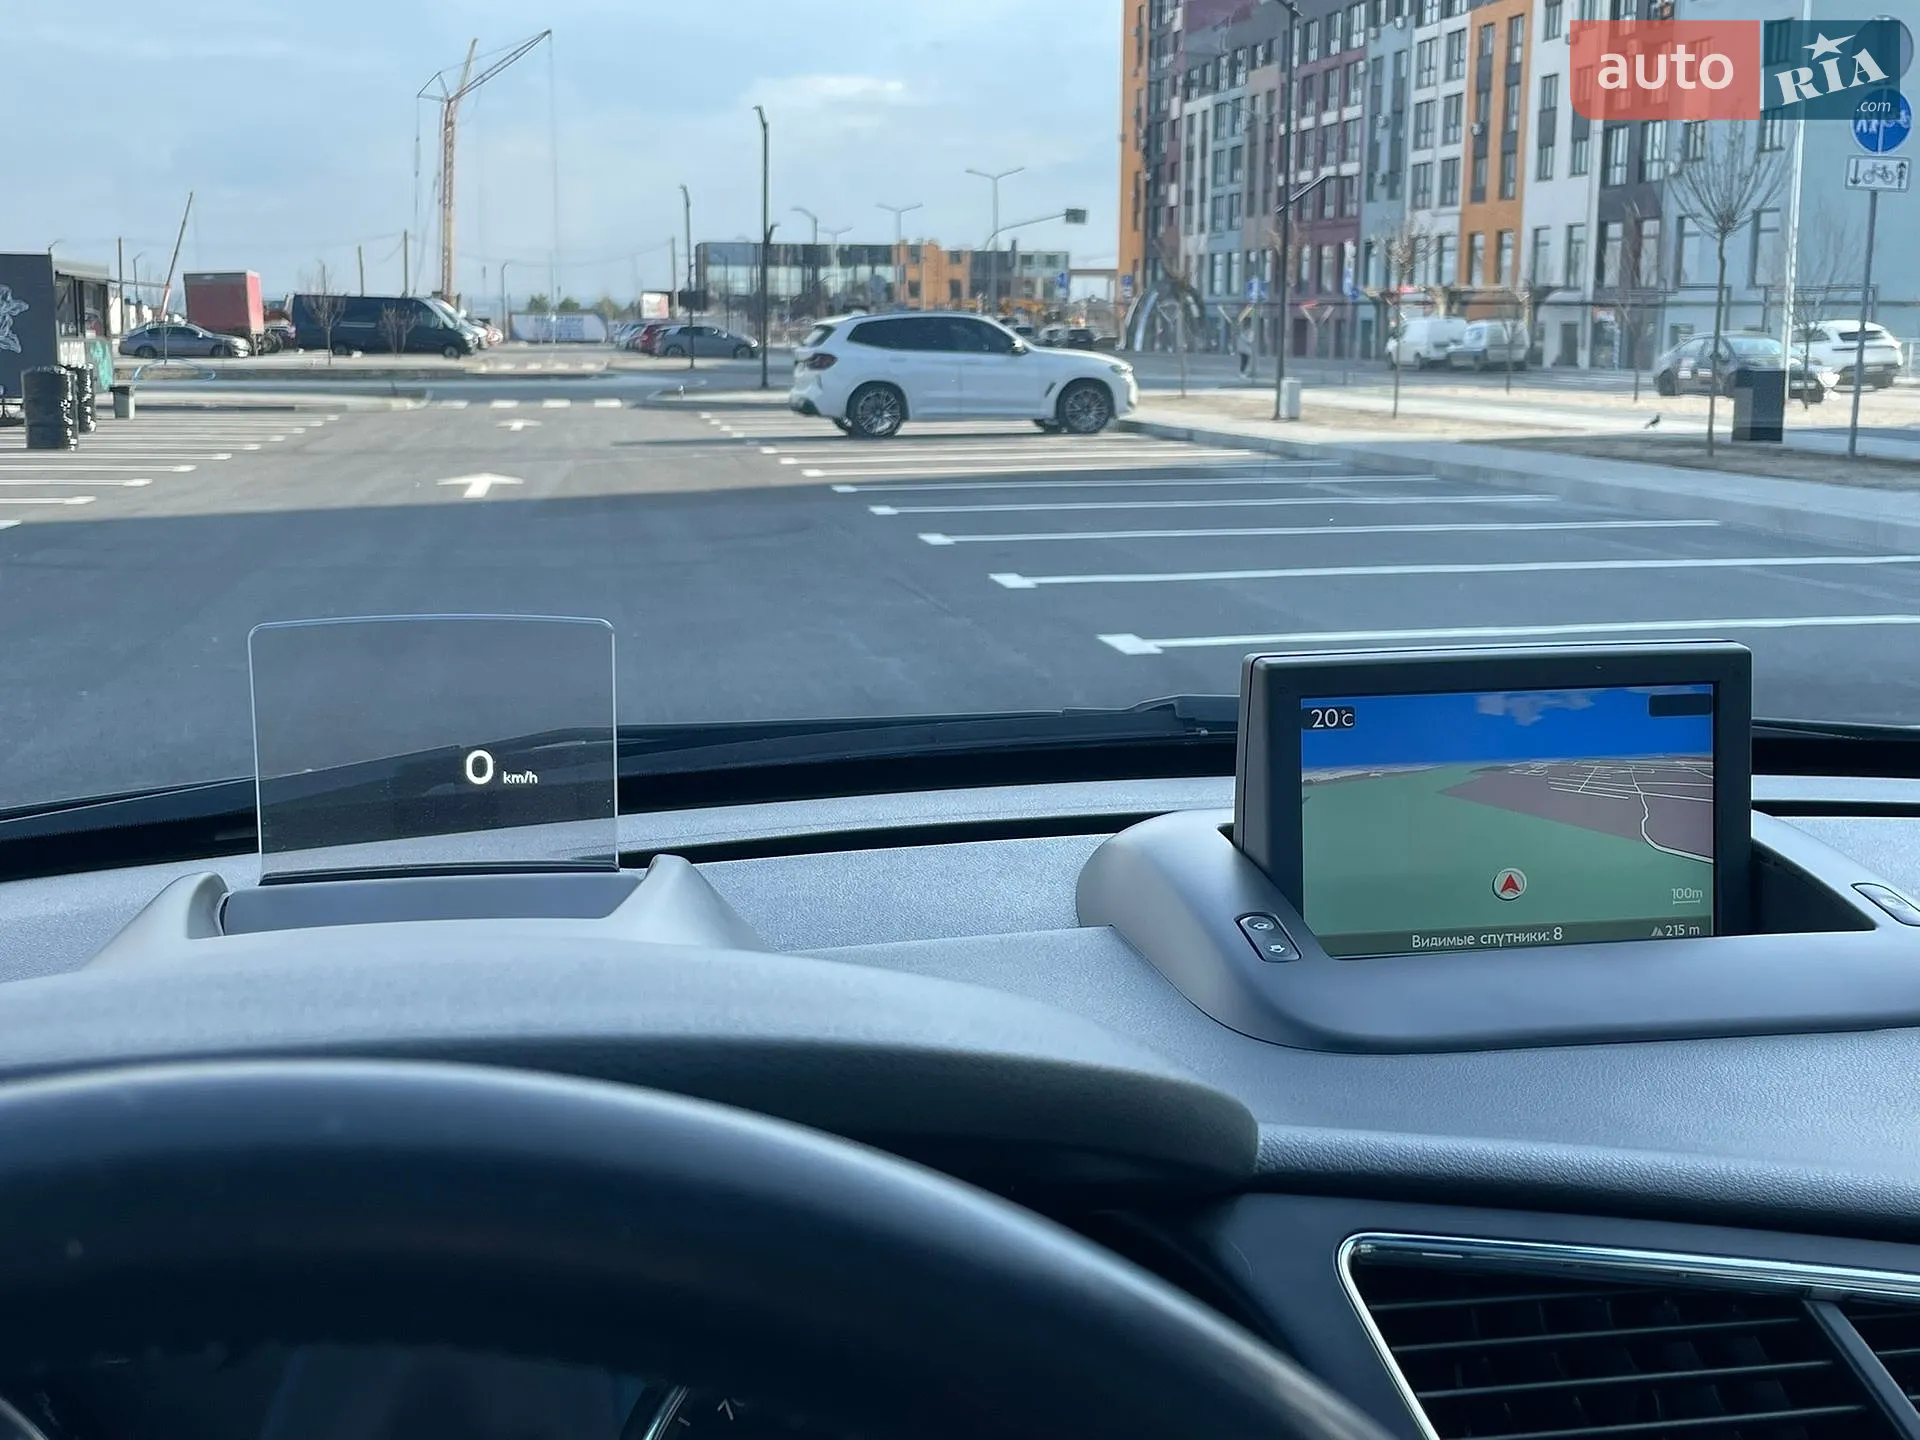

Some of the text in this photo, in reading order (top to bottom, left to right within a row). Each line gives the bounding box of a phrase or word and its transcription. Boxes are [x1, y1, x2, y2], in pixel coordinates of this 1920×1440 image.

[465, 749, 538, 785] 0 km/h
[1671, 887, 1703, 900] 100m
[1411, 926, 1563, 948] Видимые спутники: 8
[1665, 924, 1700, 936] 215 m
